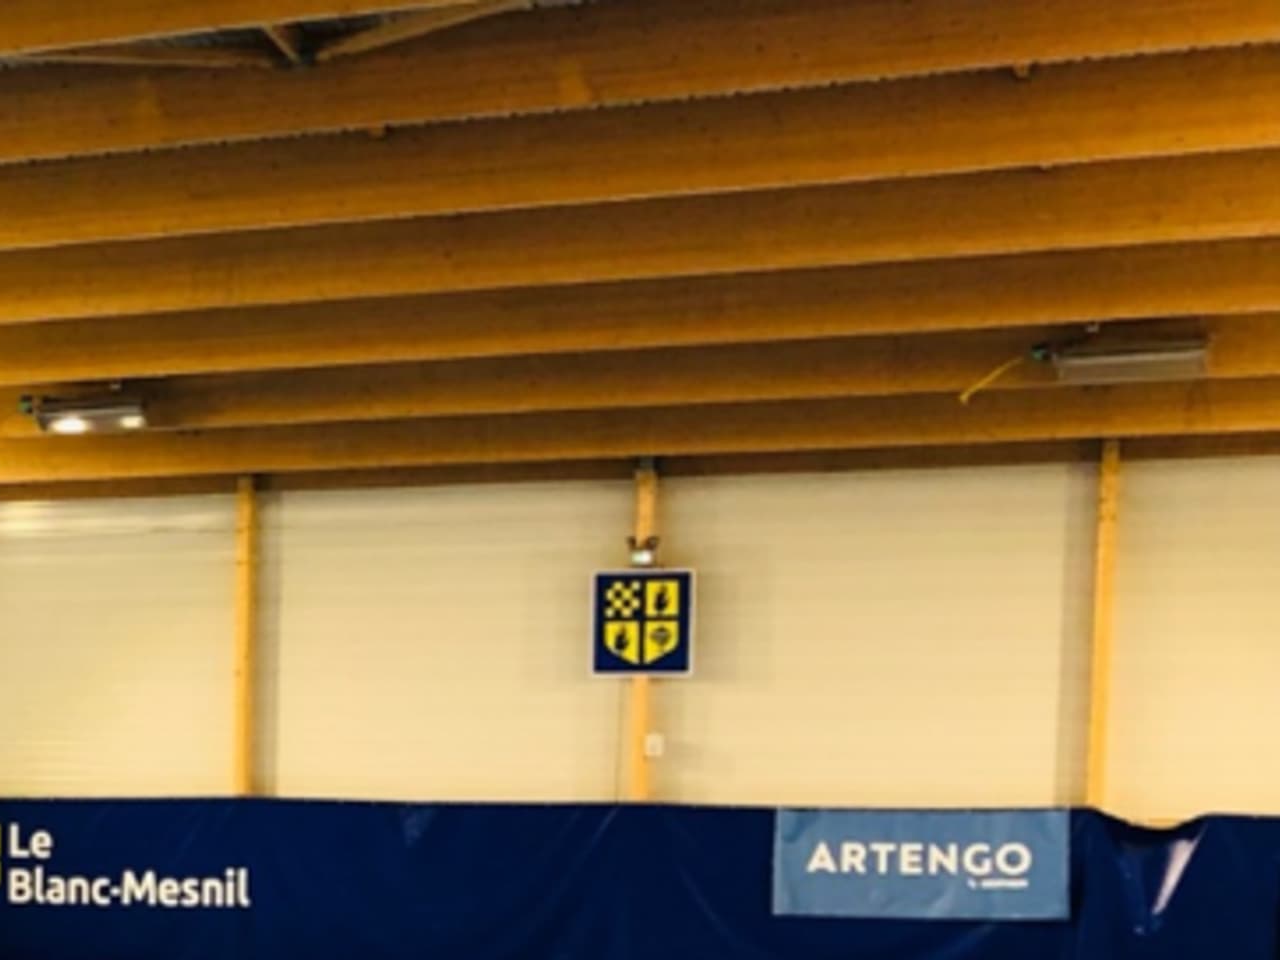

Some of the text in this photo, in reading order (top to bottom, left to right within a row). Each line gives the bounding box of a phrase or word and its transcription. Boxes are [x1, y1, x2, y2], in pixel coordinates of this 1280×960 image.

[8, 822, 53, 859] Le
[806, 841, 1033, 876] ARTENGO
[7, 866, 251, 908] Blanc-Mesnil
